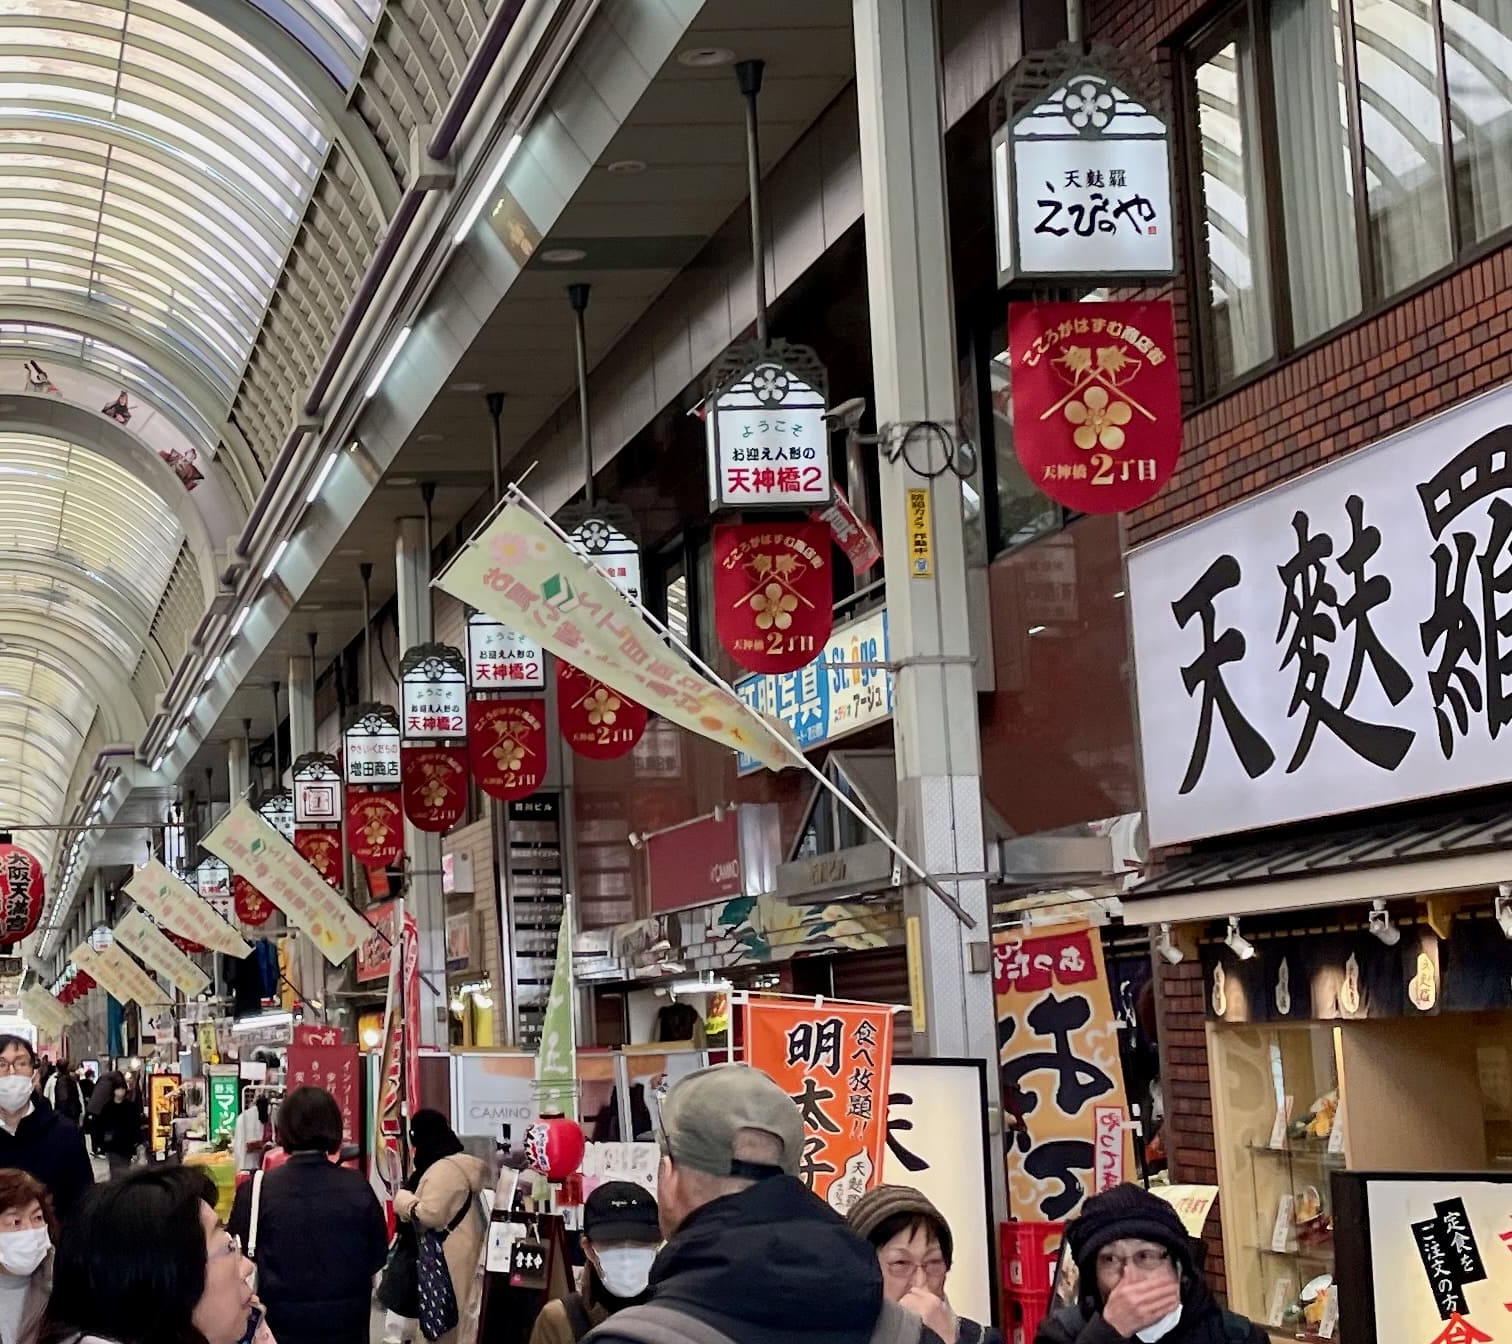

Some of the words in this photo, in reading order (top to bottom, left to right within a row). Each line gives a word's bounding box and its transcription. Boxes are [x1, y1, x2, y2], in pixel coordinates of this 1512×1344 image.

[1063, 168, 1128, 189] 天麩羅
[1021, 317, 1168, 368] こころがはずむ商店街
[742, 418, 804, 439] ようこそ
[731, 446, 816, 461] お迎え人形の
[727, 467, 824, 493] 天神橋2
[1170, 424, 1512, 795] 天麩羅
[475, 663, 539, 681] 天神橋2
[7, 853, 31, 932] 大阪天満宮
[470, 1106, 531, 1120] CAMINO
[1443, 1211, 1475, 1273] 定食を
[1421, 1223, 1458, 1312] ご注文の方
